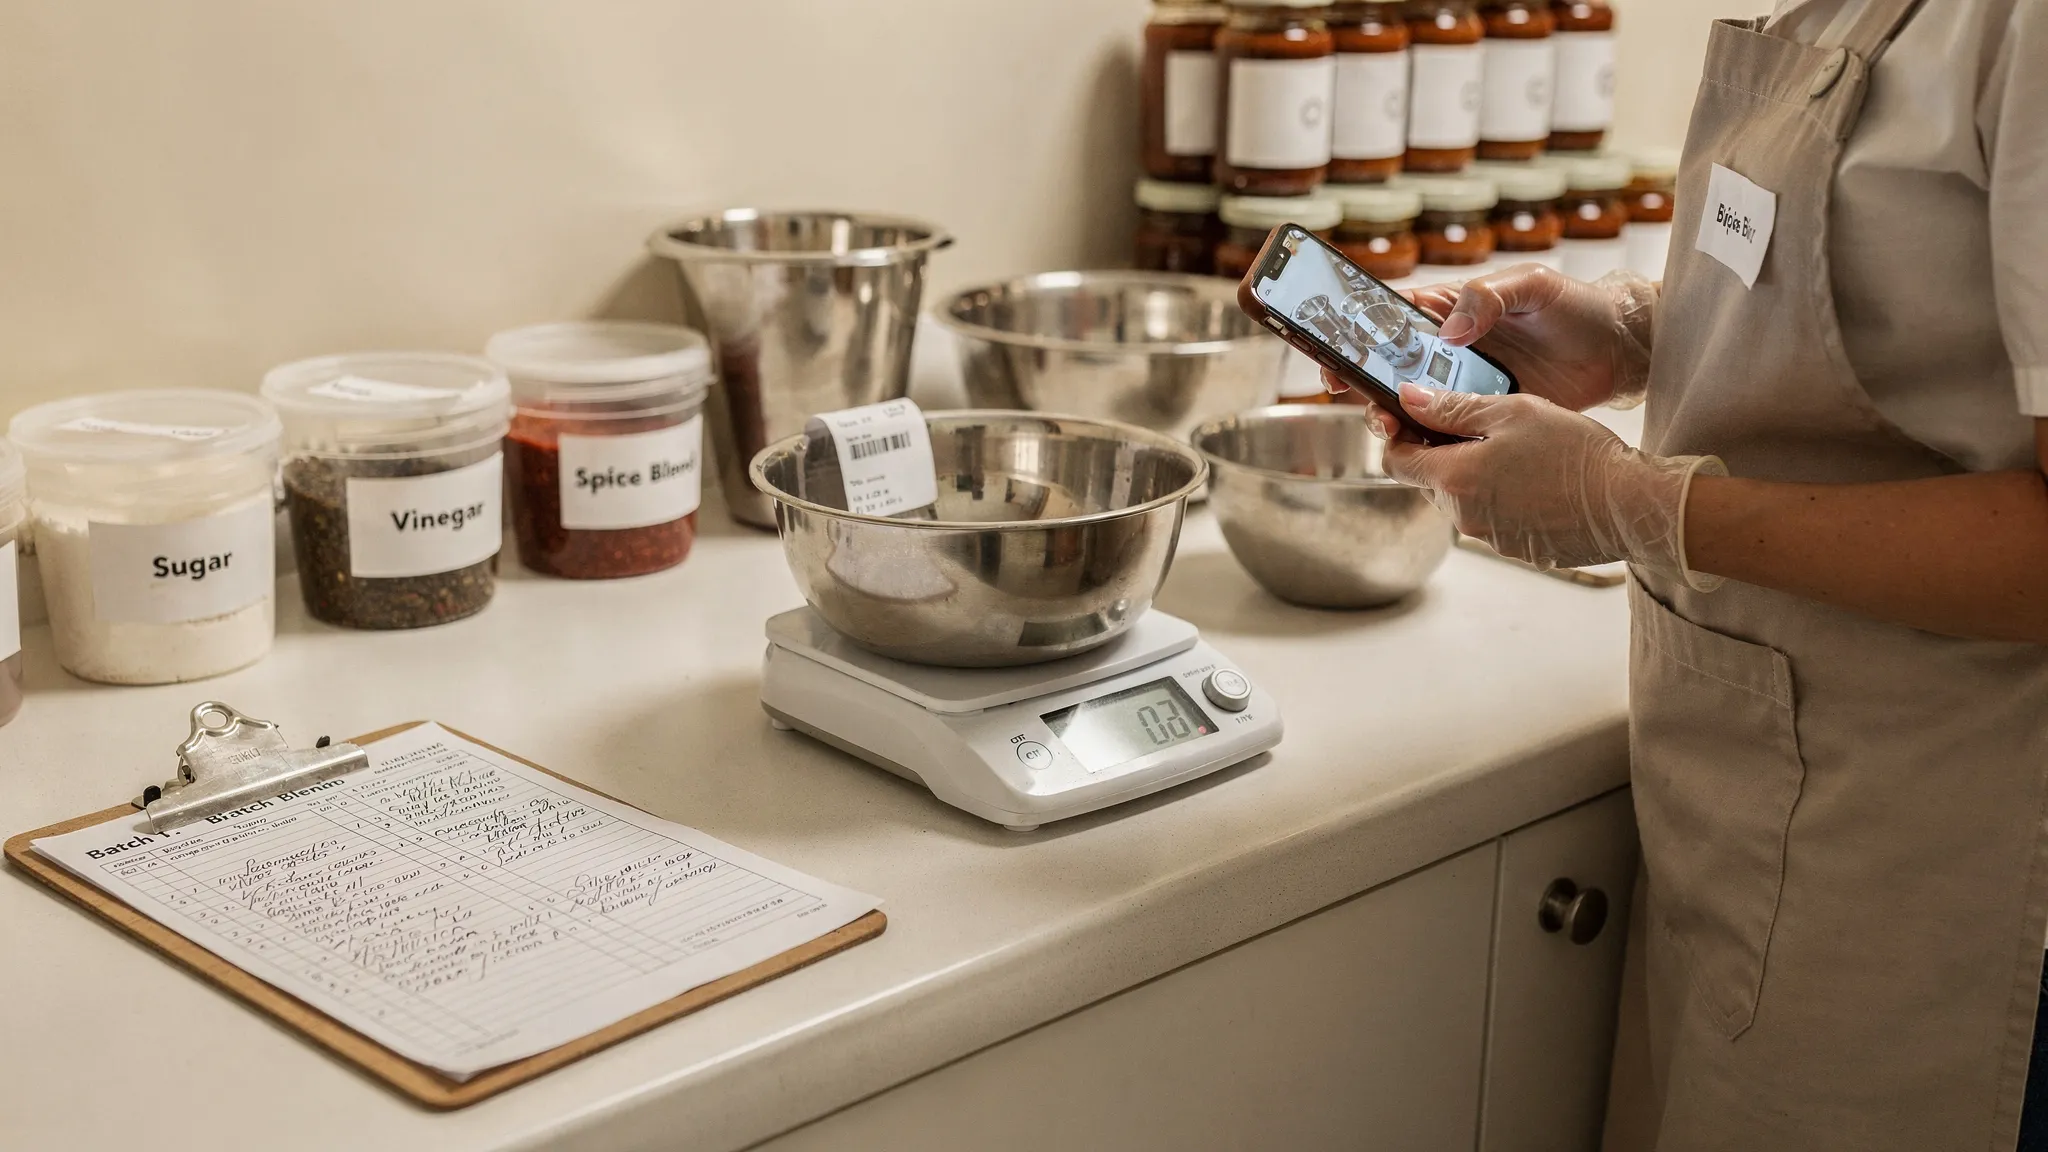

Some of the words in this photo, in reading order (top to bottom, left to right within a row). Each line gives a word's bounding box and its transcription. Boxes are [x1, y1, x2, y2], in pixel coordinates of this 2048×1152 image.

[575, 467, 641, 494] Spice
[391, 501, 484, 531] Vinegar
[153, 551, 232, 580] Sugar
[85, 835, 155, 860] Batch
